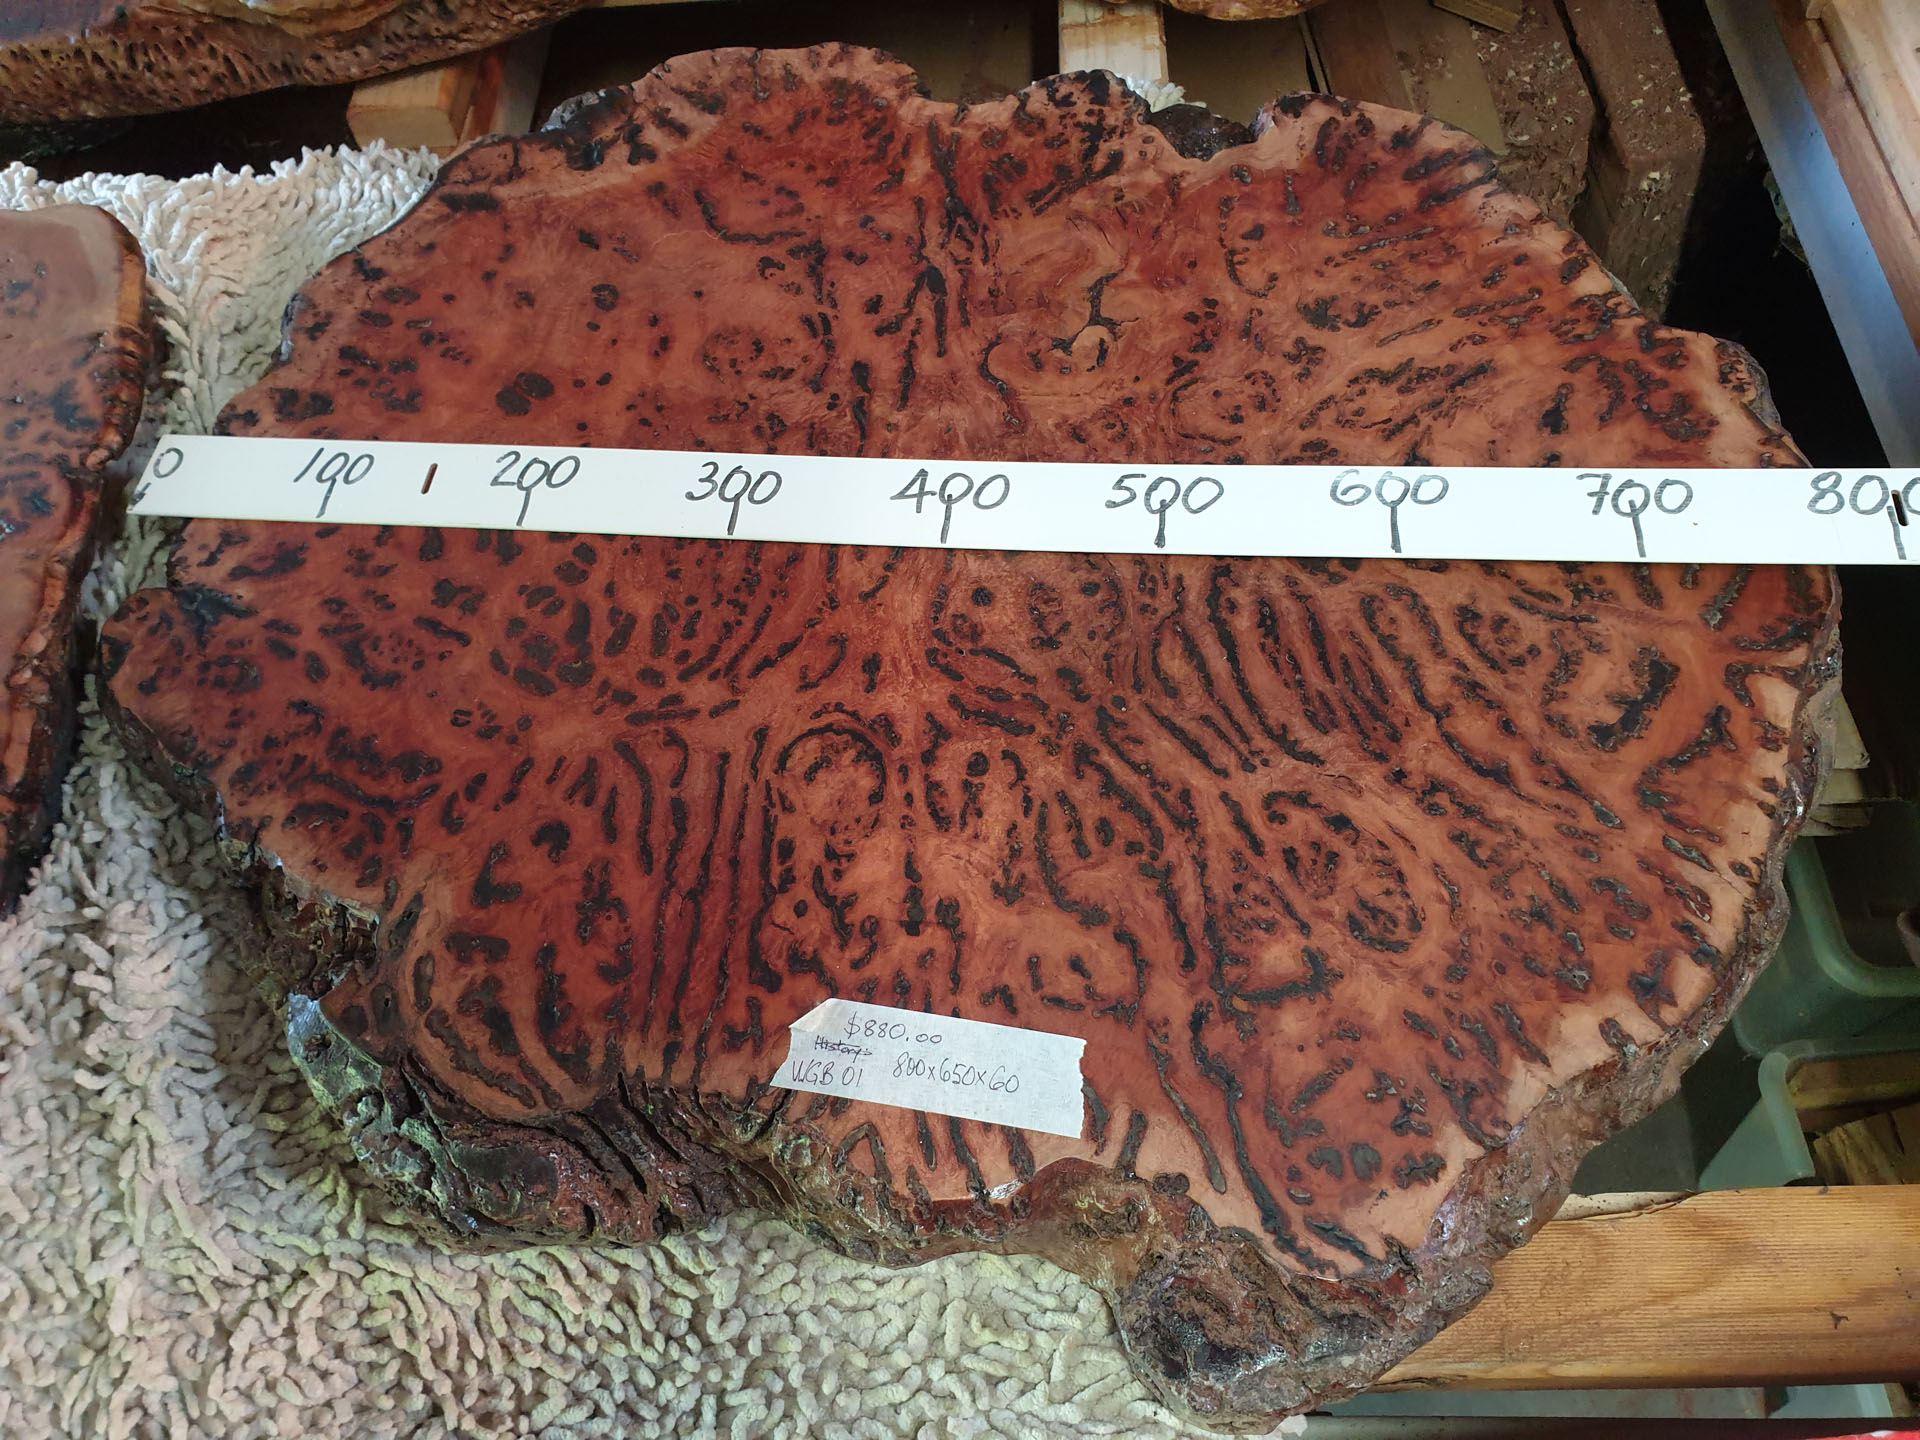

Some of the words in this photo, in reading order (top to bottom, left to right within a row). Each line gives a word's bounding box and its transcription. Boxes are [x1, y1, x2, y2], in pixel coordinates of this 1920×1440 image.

[153, 447, 184, 478] 0
[294, 447, 375, 485] 100
[490, 450, 581, 491] 200
[685, 461, 783, 505] 300
[890, 468, 1011, 514] 400
[1105, 473, 1224, 515] 500
[1329, 469, 1449, 507] 600
[1575, 473, 1694, 517] 700
[844, 1010, 942, 1044] $880.00
